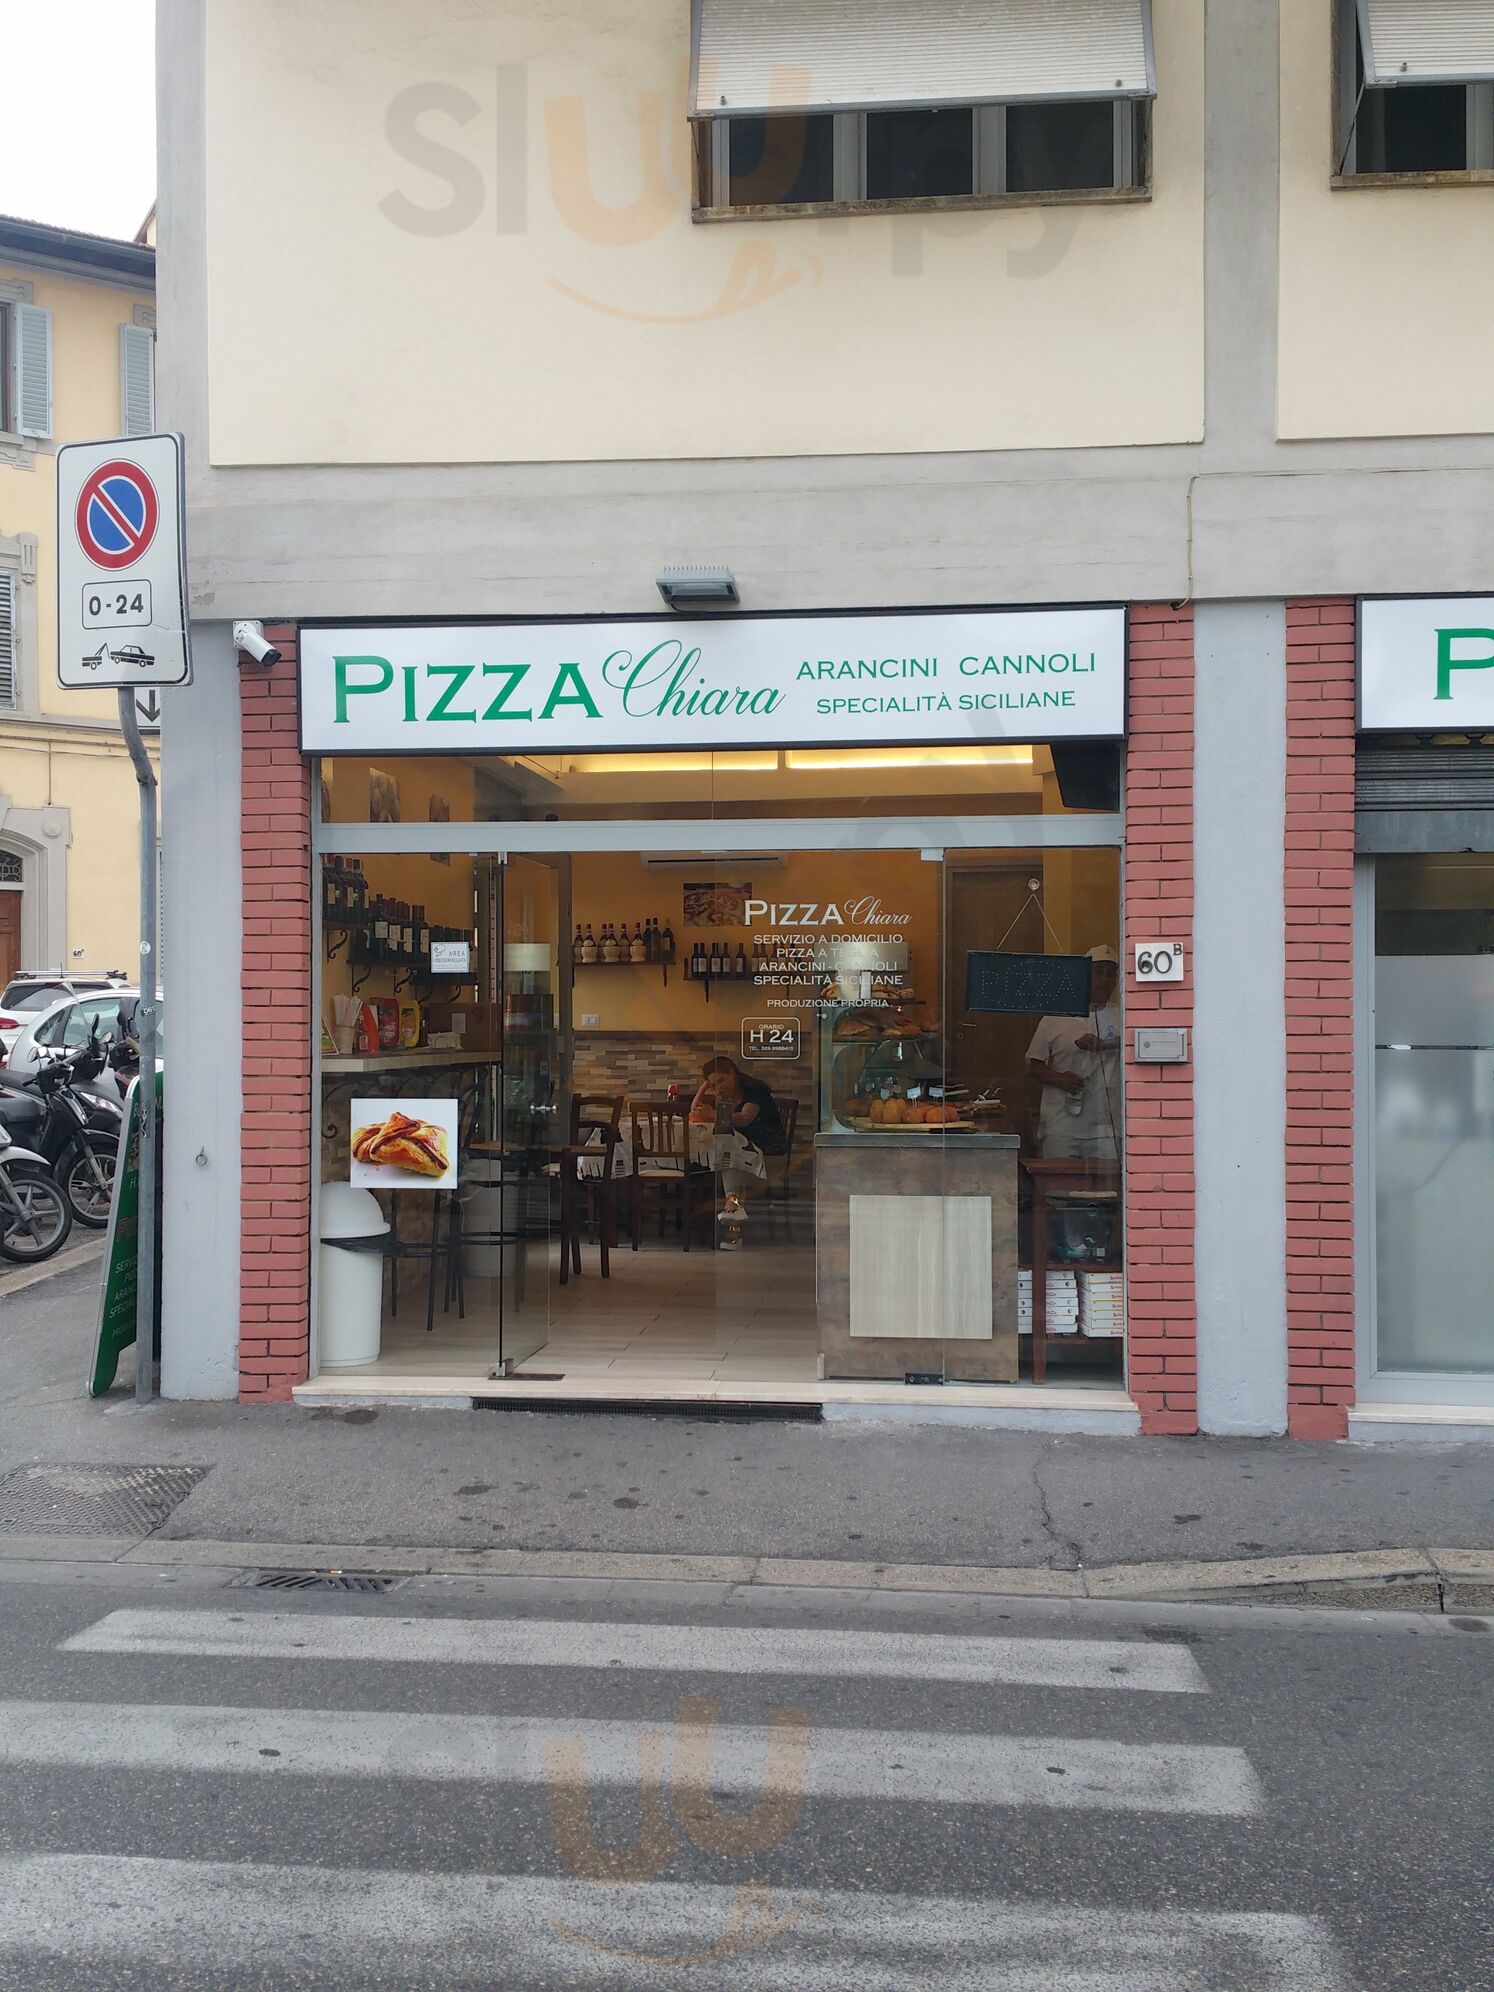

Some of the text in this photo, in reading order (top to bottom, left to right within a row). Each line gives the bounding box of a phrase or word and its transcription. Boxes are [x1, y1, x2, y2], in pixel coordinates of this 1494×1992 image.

[796, 652, 1096, 680] ARANCINI CANNOLI
[602, 639, 786, 717] Chiara
[816, 690, 1076, 714] SPECIALITÀ SICILIANE
[843, 895, 912, 926] Chiara
[753, 933, 903, 945] SERVIZIO A DOMICILIO
[776, 947, 879, 958] PIZZA A TEGLA
[753, 973, 832, 985] SPECIALITÀ
[981, 969, 1077, 999] PIZZA
[767, 999, 838, 1008] PRODUZIONE
[749, 1029, 794, 1043] H 24
